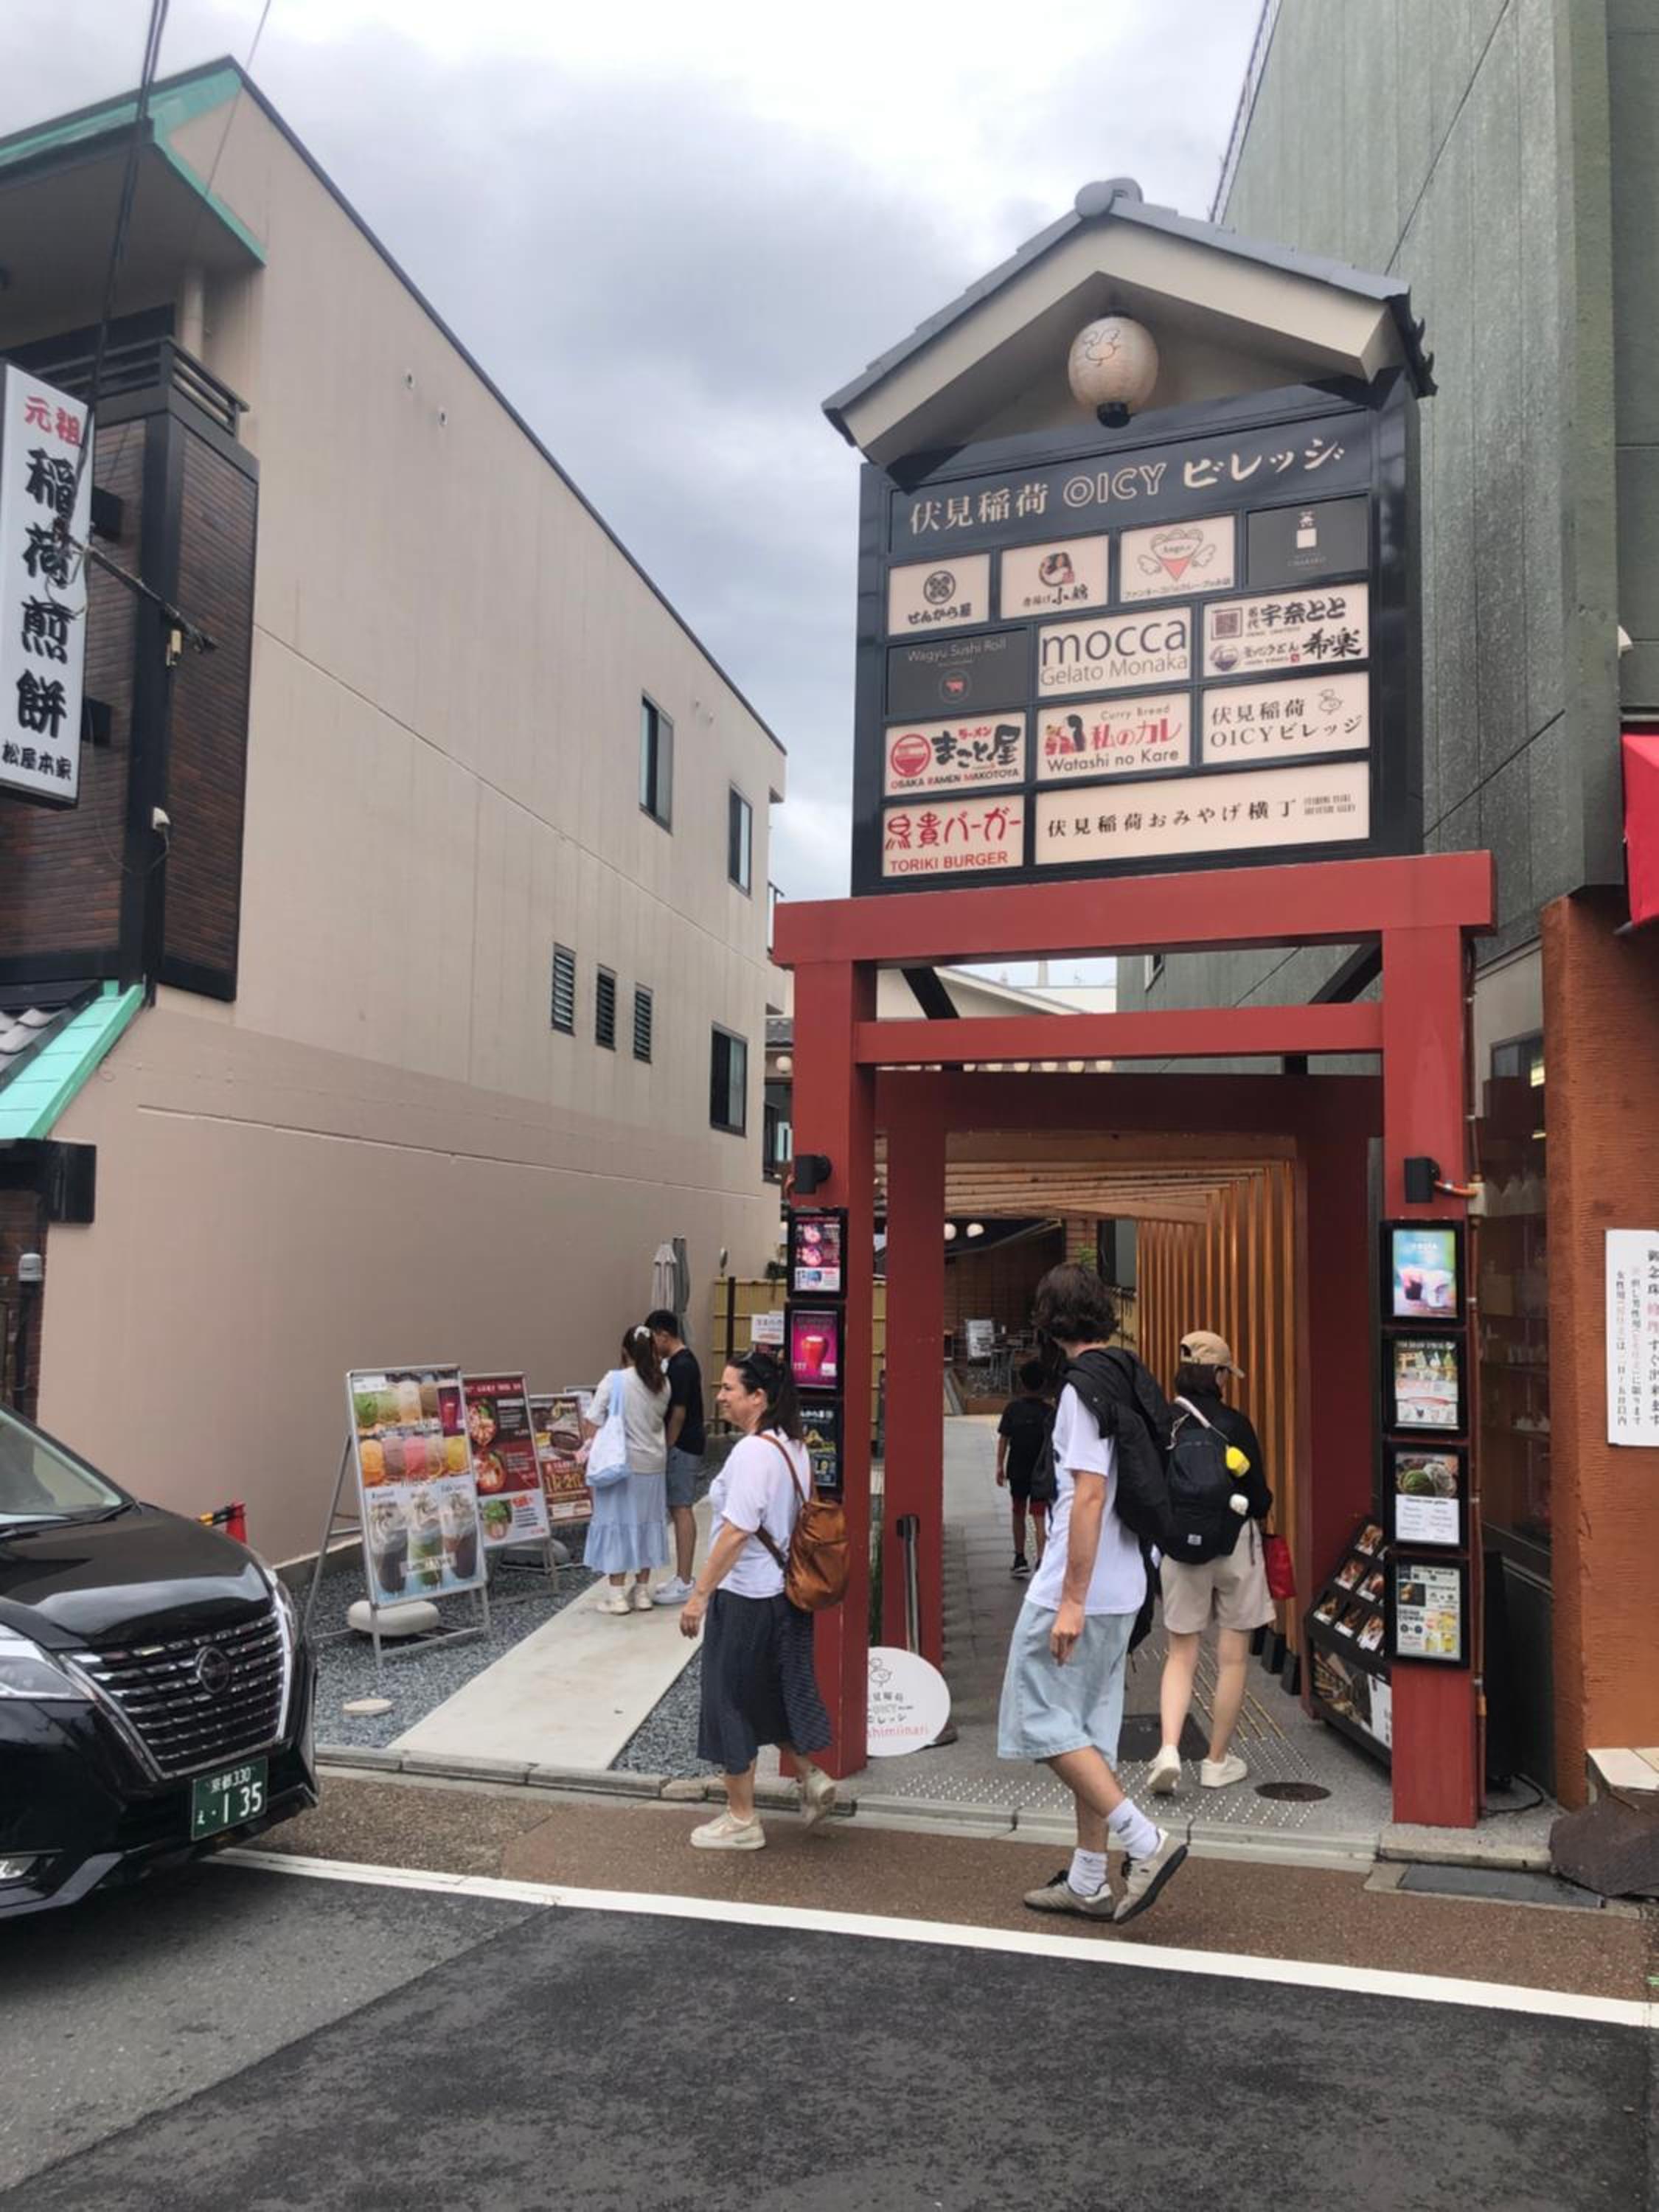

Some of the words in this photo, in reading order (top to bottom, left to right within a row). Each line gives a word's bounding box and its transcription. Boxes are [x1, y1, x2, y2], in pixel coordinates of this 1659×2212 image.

[24, 396, 82, 446] 元祖
[911, 483, 1048, 535] 伏見稲荷
[1063, 462, 1166, 507] OICY
[1183, 439, 1345, 489] ビレッジ
[16, 447, 76, 739] 稲荷煎餅
[1261, 597, 1346, 626] 宇奈とと
[908, 650, 947, 662] Wagyu
[950, 643, 981, 657] Sushi
[984, 637, 1006, 651] Roll
[1043, 620, 1186, 667] mocca
[1040, 665, 1104, 686] Gelato
[1109, 653, 1188, 678] Monaka
[1101, 710, 1132, 721] Curry
[1137, 705, 1170, 717] Bread
[1212, 698, 1305, 726] 伏見稲荷
[931, 724, 1021, 768] まこと屋
[1047, 754, 1109, 772] Watashi
[1115, 754, 1135, 766] no
[1141, 748, 1179, 764] Kare
[891, 778, 925, 790] OSAKA
[928, 774, 961, 785] RAMEN
[964, 768, 1019, 782] MAKOTOYA
[1048, 798, 1297, 838] 伏見稲荷おみやげ横丁
[890, 857, 939, 873] TORIKI
[943, 851, 1009, 869] BURGER
